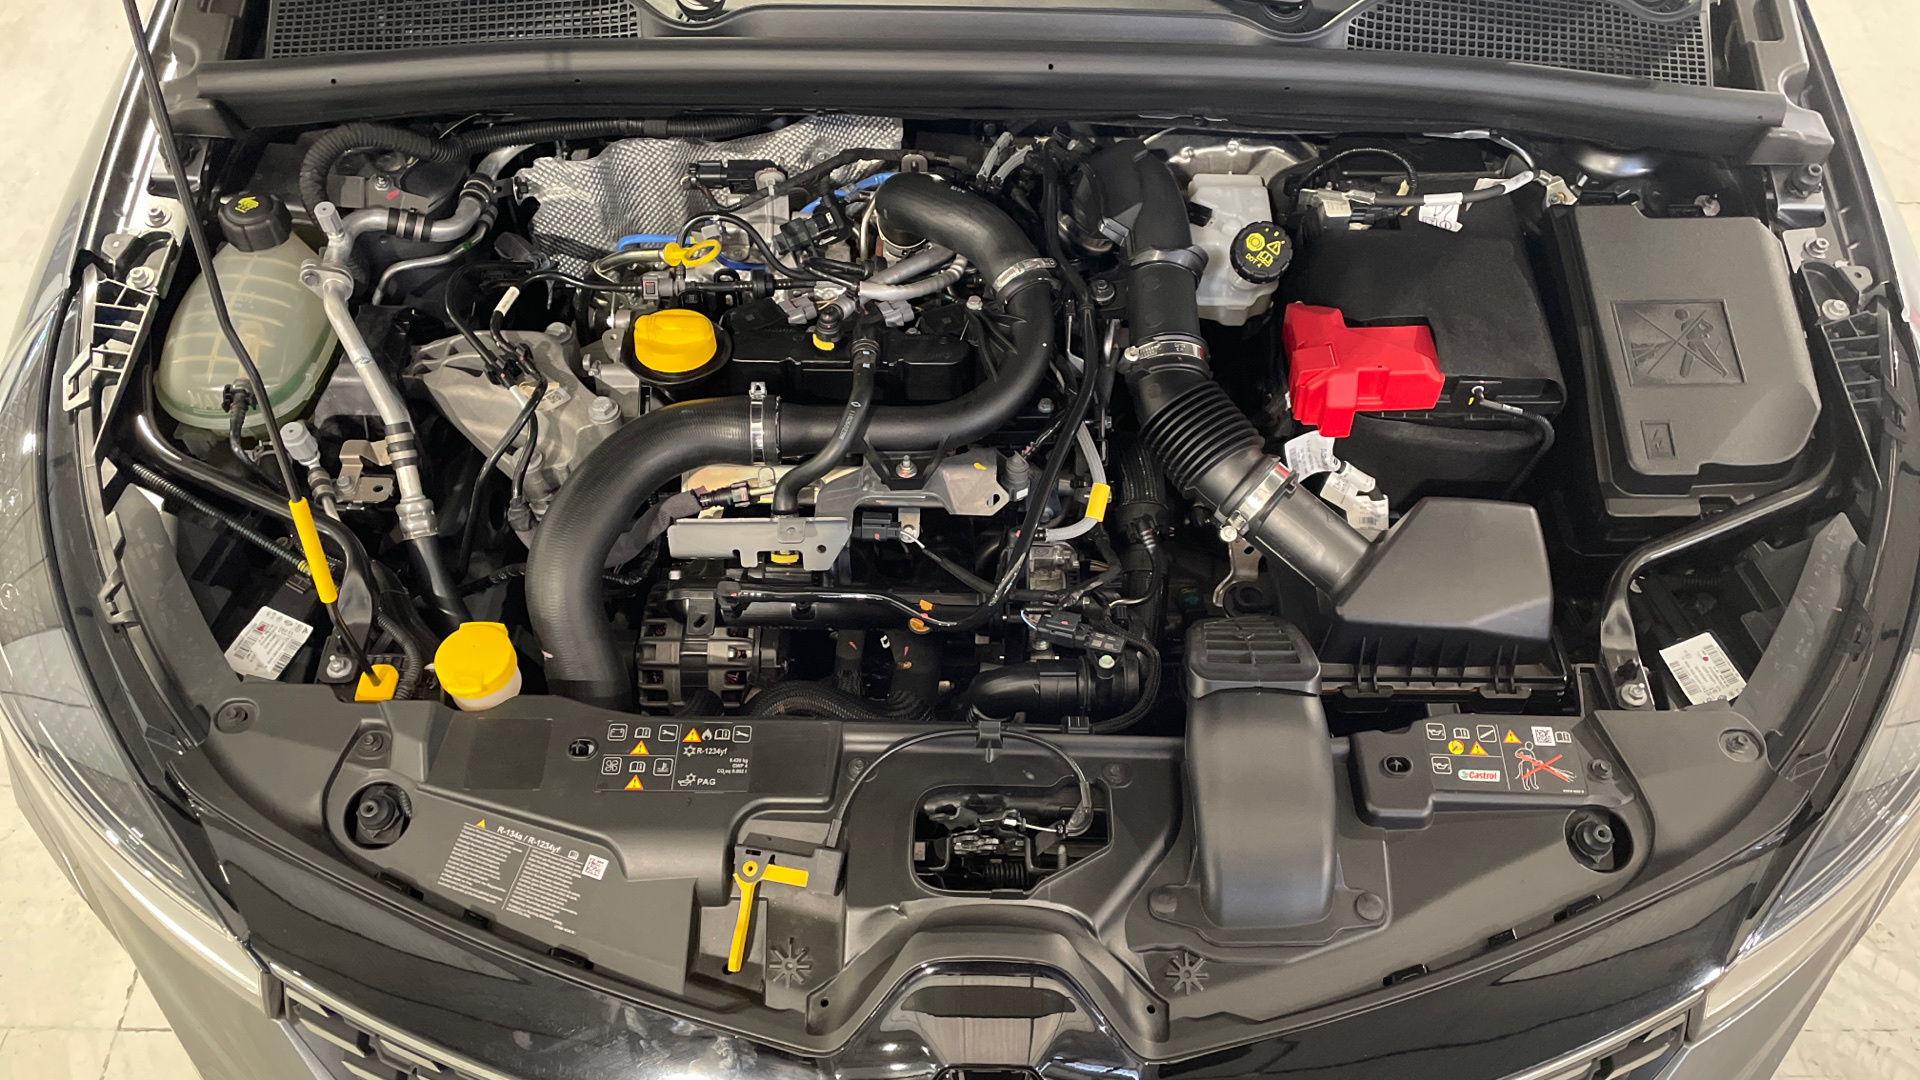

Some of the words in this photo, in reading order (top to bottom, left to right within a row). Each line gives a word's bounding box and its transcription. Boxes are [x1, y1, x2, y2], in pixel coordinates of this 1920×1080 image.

[1245, 253, 1258, 264] DOT
[696, 747, 728, 757] R-1234yf
[1468, 771, 1497, 780] Castrol
[696, 778, 716, 786] PAG
[496, 826, 523, 841] R-134a
[527, 836, 562, 854] R-1234yf
